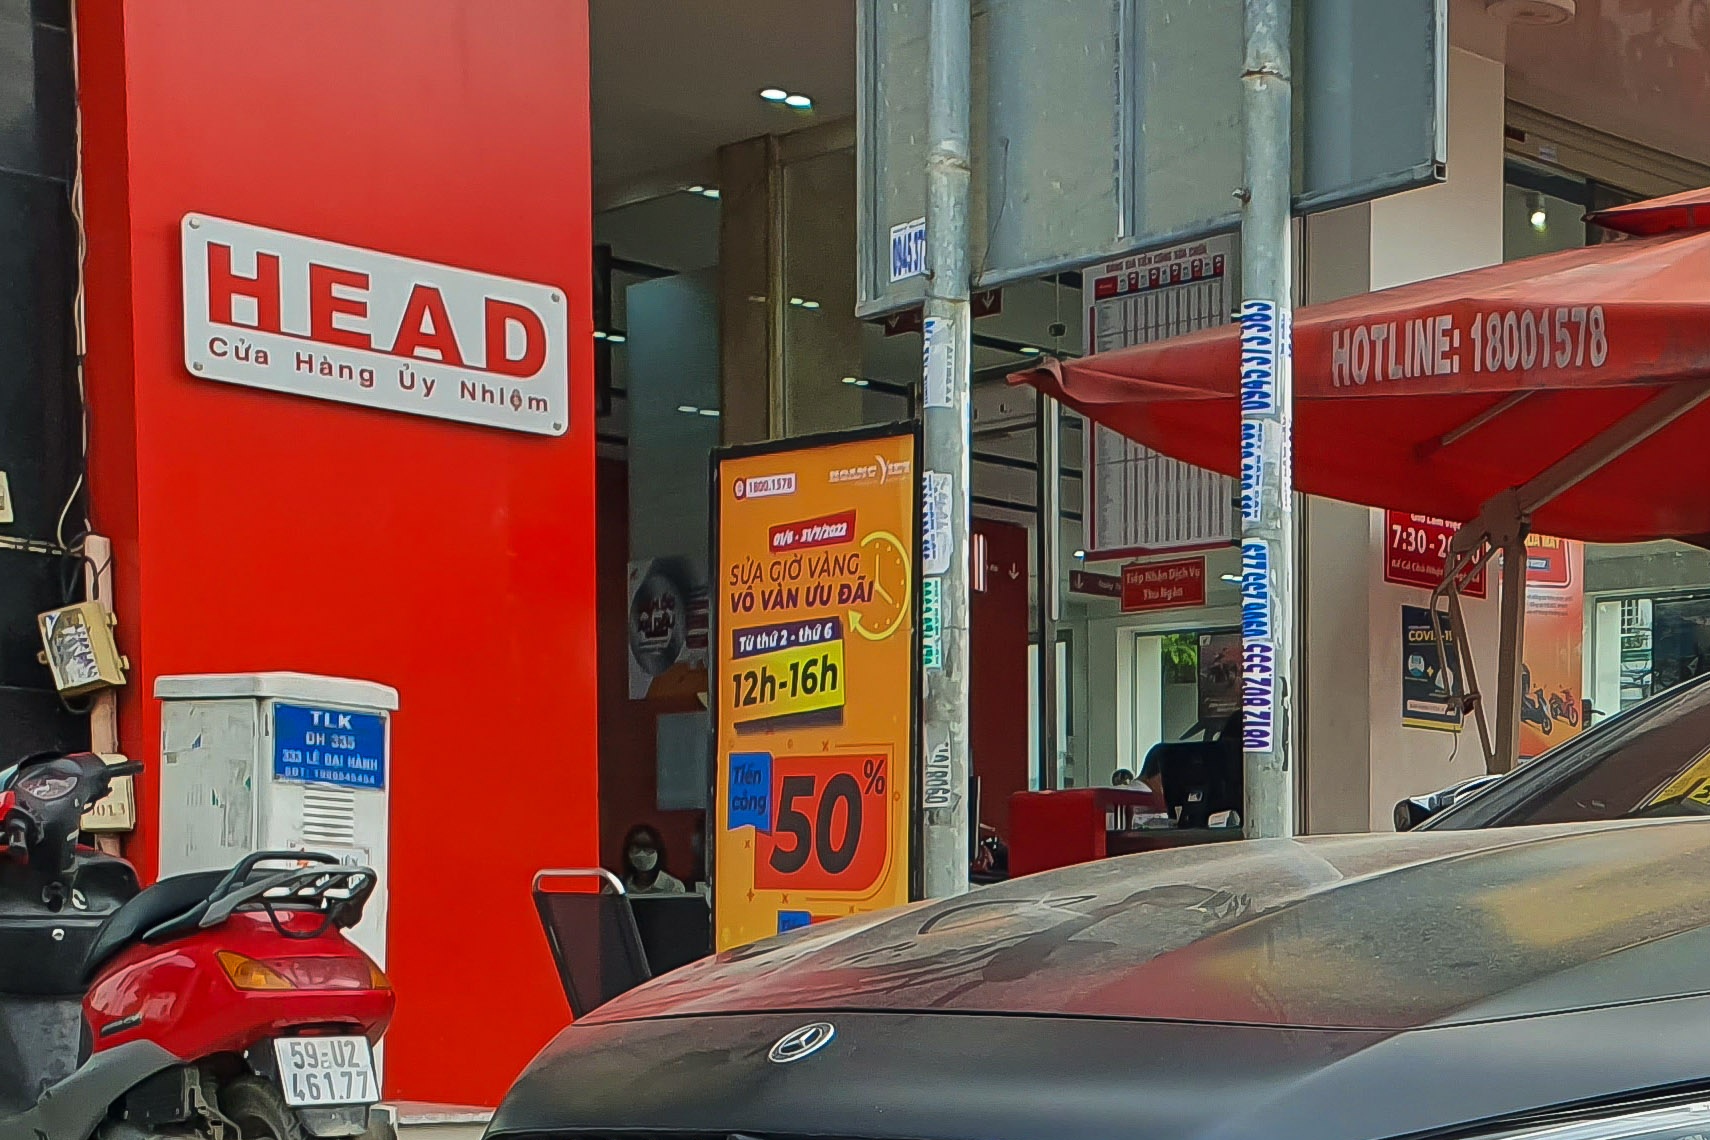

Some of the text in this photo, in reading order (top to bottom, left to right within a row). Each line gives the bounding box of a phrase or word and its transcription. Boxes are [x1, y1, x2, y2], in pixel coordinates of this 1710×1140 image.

[207, 241, 547, 378] HEAD
[1331, 314, 1460, 388] HOTLINE:
[1471, 305, 1608, 372] 18001578
[209, 336, 549, 412] Cửa Hàng Ủy Nhiệm
[1392, 524, 1427, 554] 7:30
[730, 550, 860, 586] SỬA GIỜ VÀNG
[730, 576, 875, 613] VÔ VÀN ƯU ĐÃI
[780, 631, 787, 646] 2
[824, 622, 832, 639] 6
[732, 653, 838, 708] 12h-16h
[310, 711, 352, 730] TLK
[769, 759, 885, 875] 50%
[292, 1070, 368, 1101] 461.77
